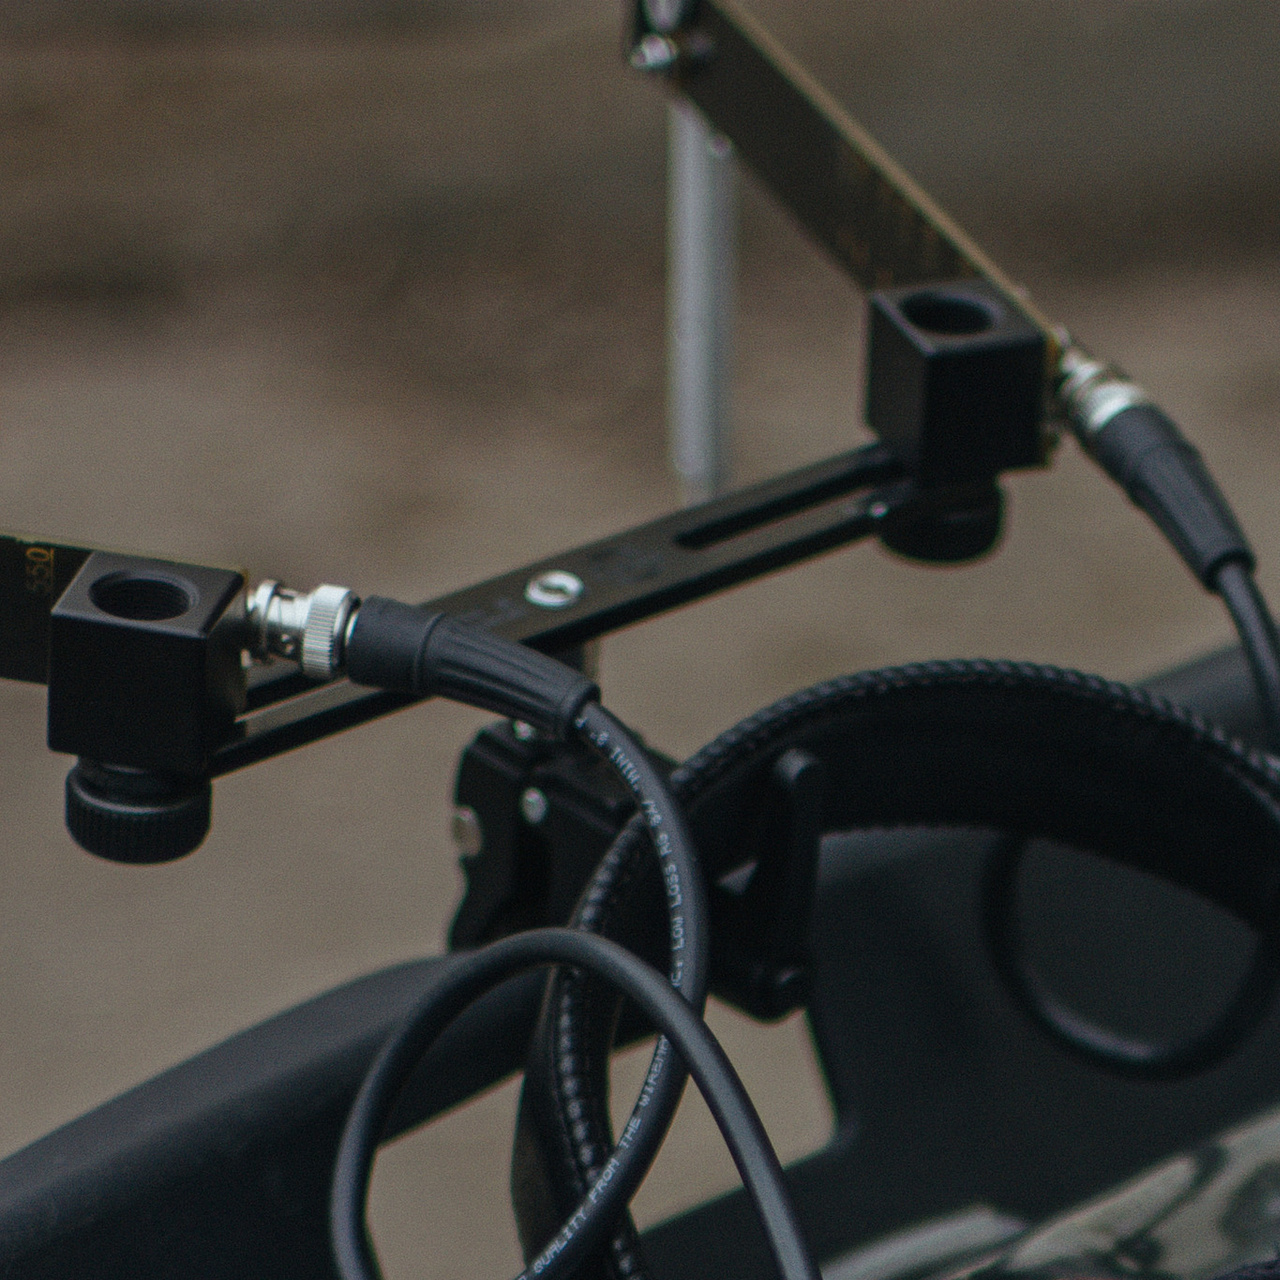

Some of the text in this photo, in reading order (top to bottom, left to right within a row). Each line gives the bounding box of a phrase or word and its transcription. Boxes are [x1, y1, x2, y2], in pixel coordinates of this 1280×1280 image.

[665, 863, 682, 909] LOSS
[672, 916, 685, 950] LOW
[533, 1206, 587, 1274] QUALITY
[588, 1157, 620, 1203] FROM
[619, 1117, 642, 1149] THE
[639, 1035, 669, 1107] WIREMA
